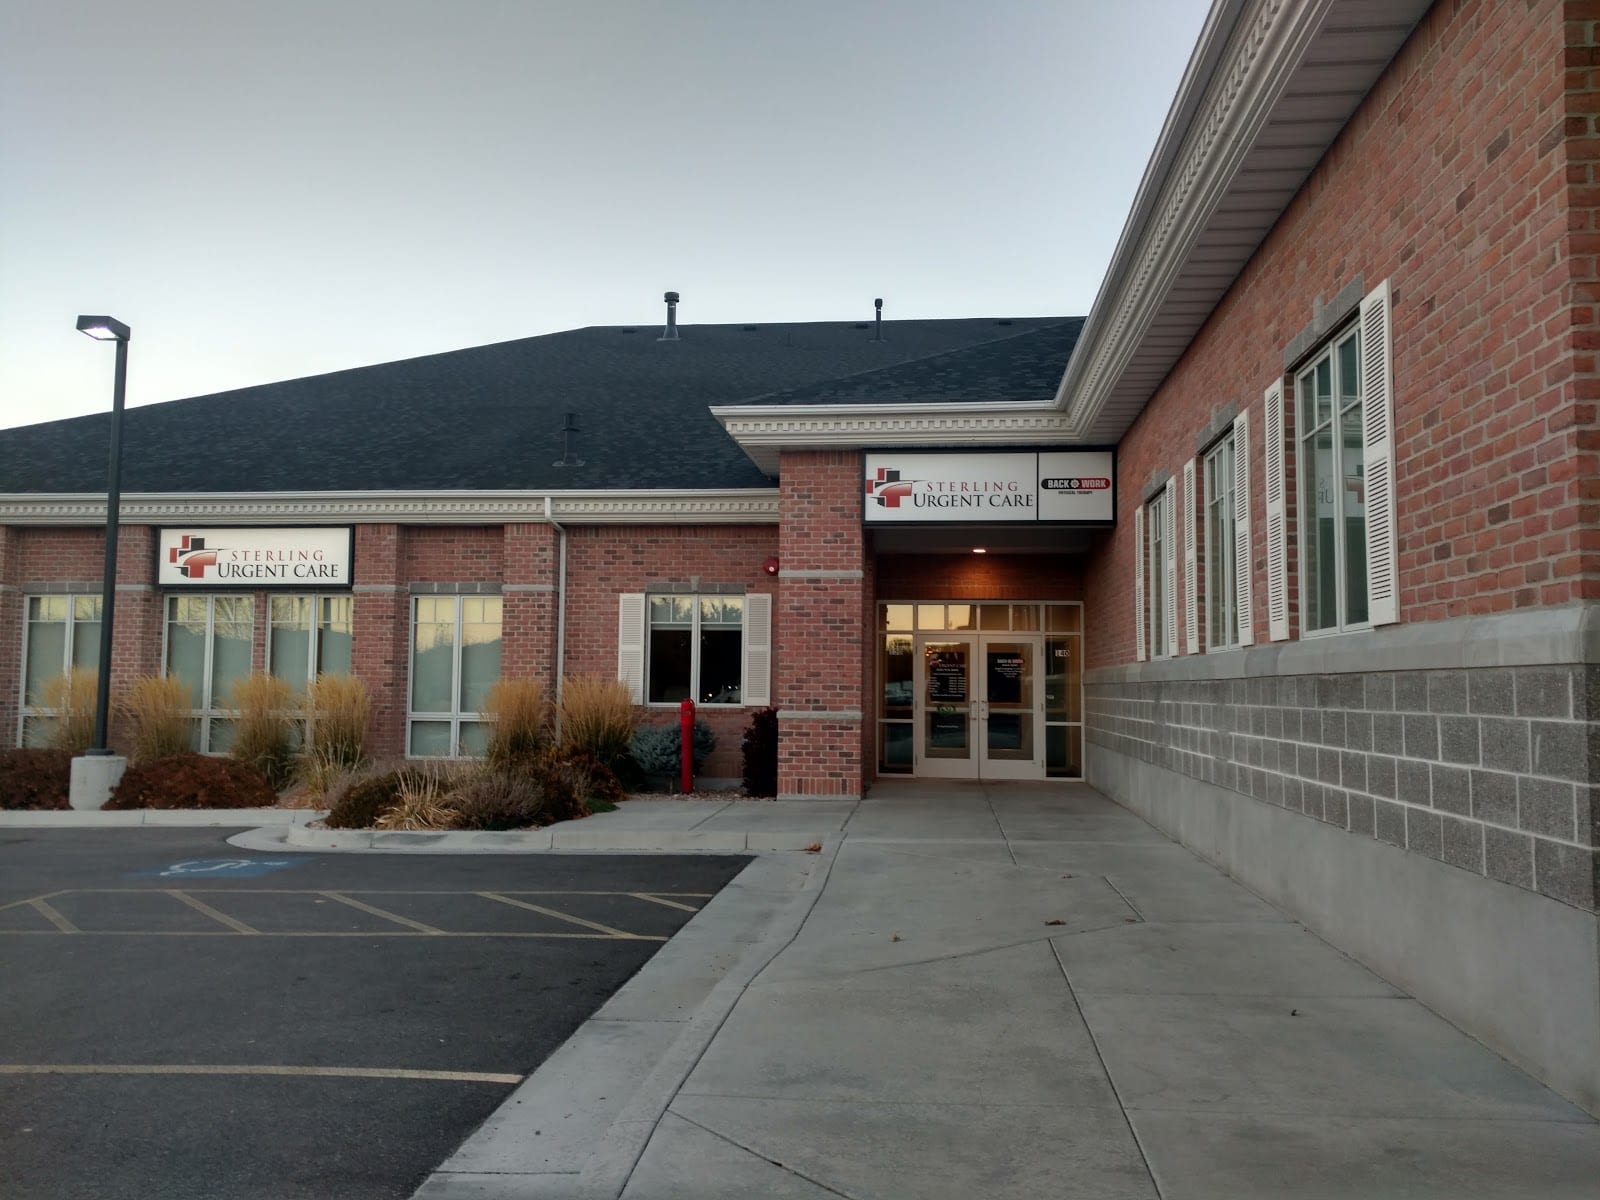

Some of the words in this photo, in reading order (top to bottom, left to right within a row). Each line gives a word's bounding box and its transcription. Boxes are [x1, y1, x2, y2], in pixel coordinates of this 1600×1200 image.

[926, 481, 1019, 492] STERLING
[1047, 479, 1070, 489] BACK
[1081, 479, 1106, 489] WORK
[913, 493, 984, 507] URGENT
[989, 494, 1033, 507] CARE
[231, 550, 324, 561] STERLING
[218, 562, 288, 577] URGENT
[294, 563, 339, 577] CARE
